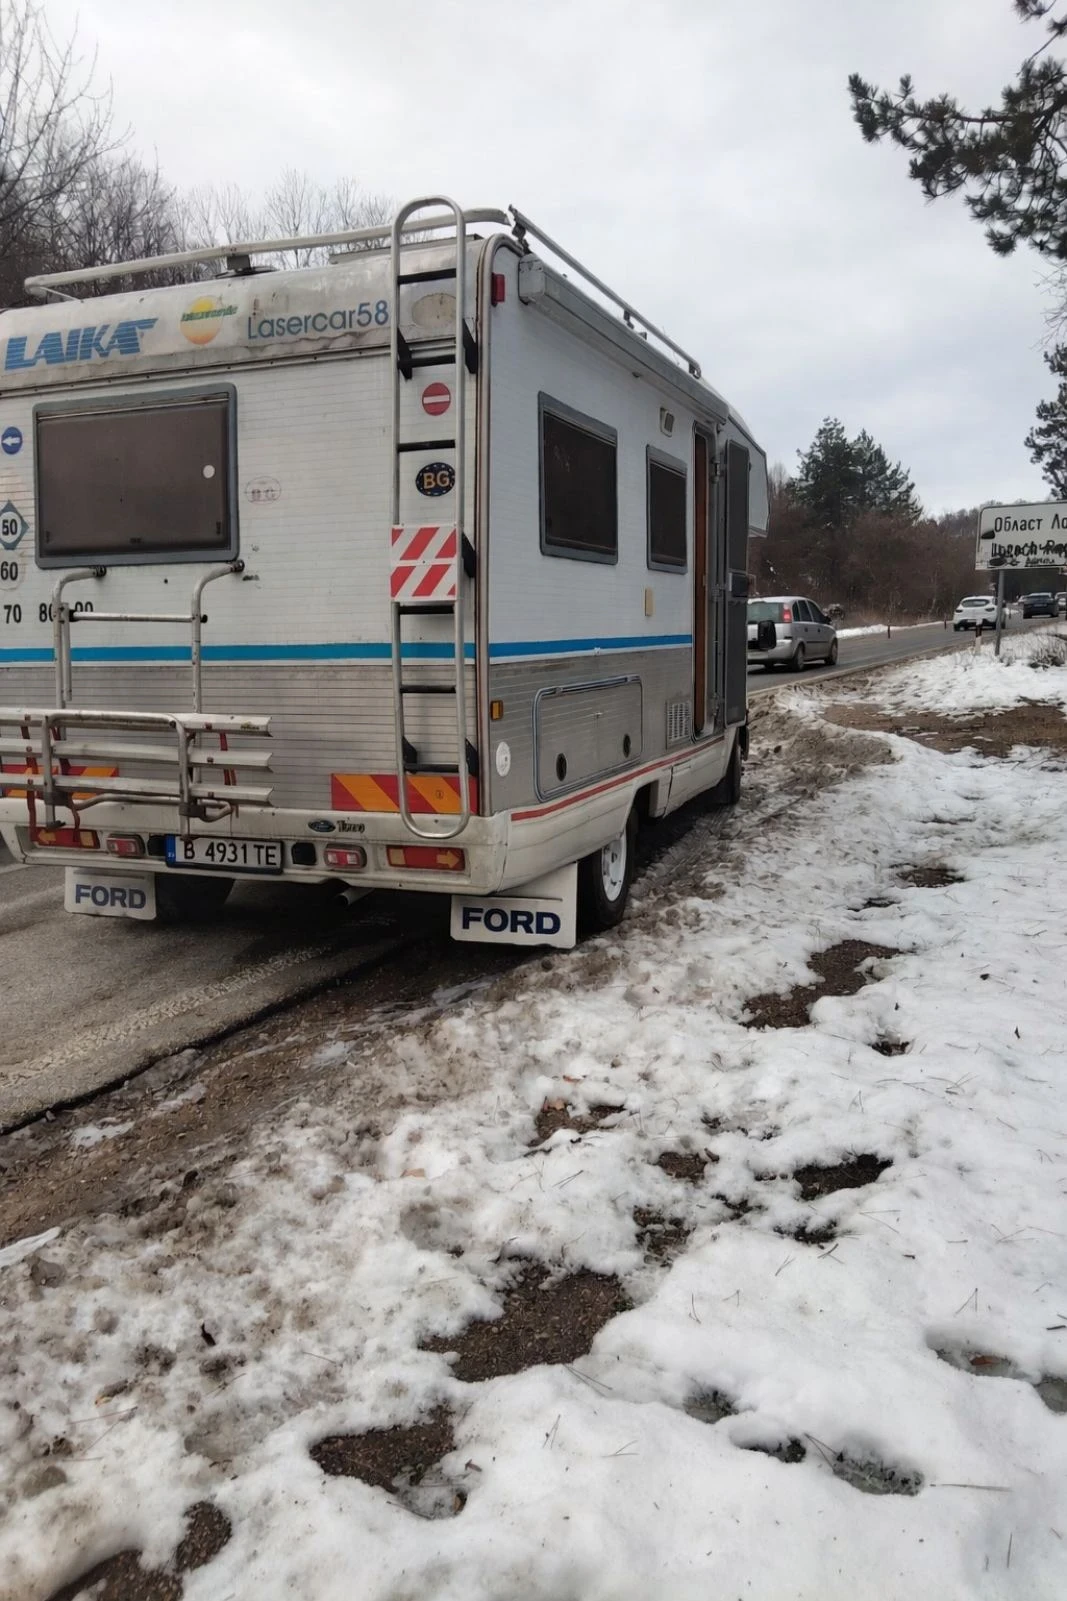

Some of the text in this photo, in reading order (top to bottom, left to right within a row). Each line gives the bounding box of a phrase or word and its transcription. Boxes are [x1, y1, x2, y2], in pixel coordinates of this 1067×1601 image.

[247, 299, 389, 340] Lasercar58
[4, 318, 159, 370] LAIKA
[423, 470, 450, 490] BG
[2, 519, 18, 536] 50
[994, 516, 1043, 533] Област
[0, 561, 19, 581] 60
[3, 604, 22, 624] 70
[184, 840, 277, 866] B 4931 TE
[75, 884, 147, 909] FORD
[462, 906, 561, 935] FORD
